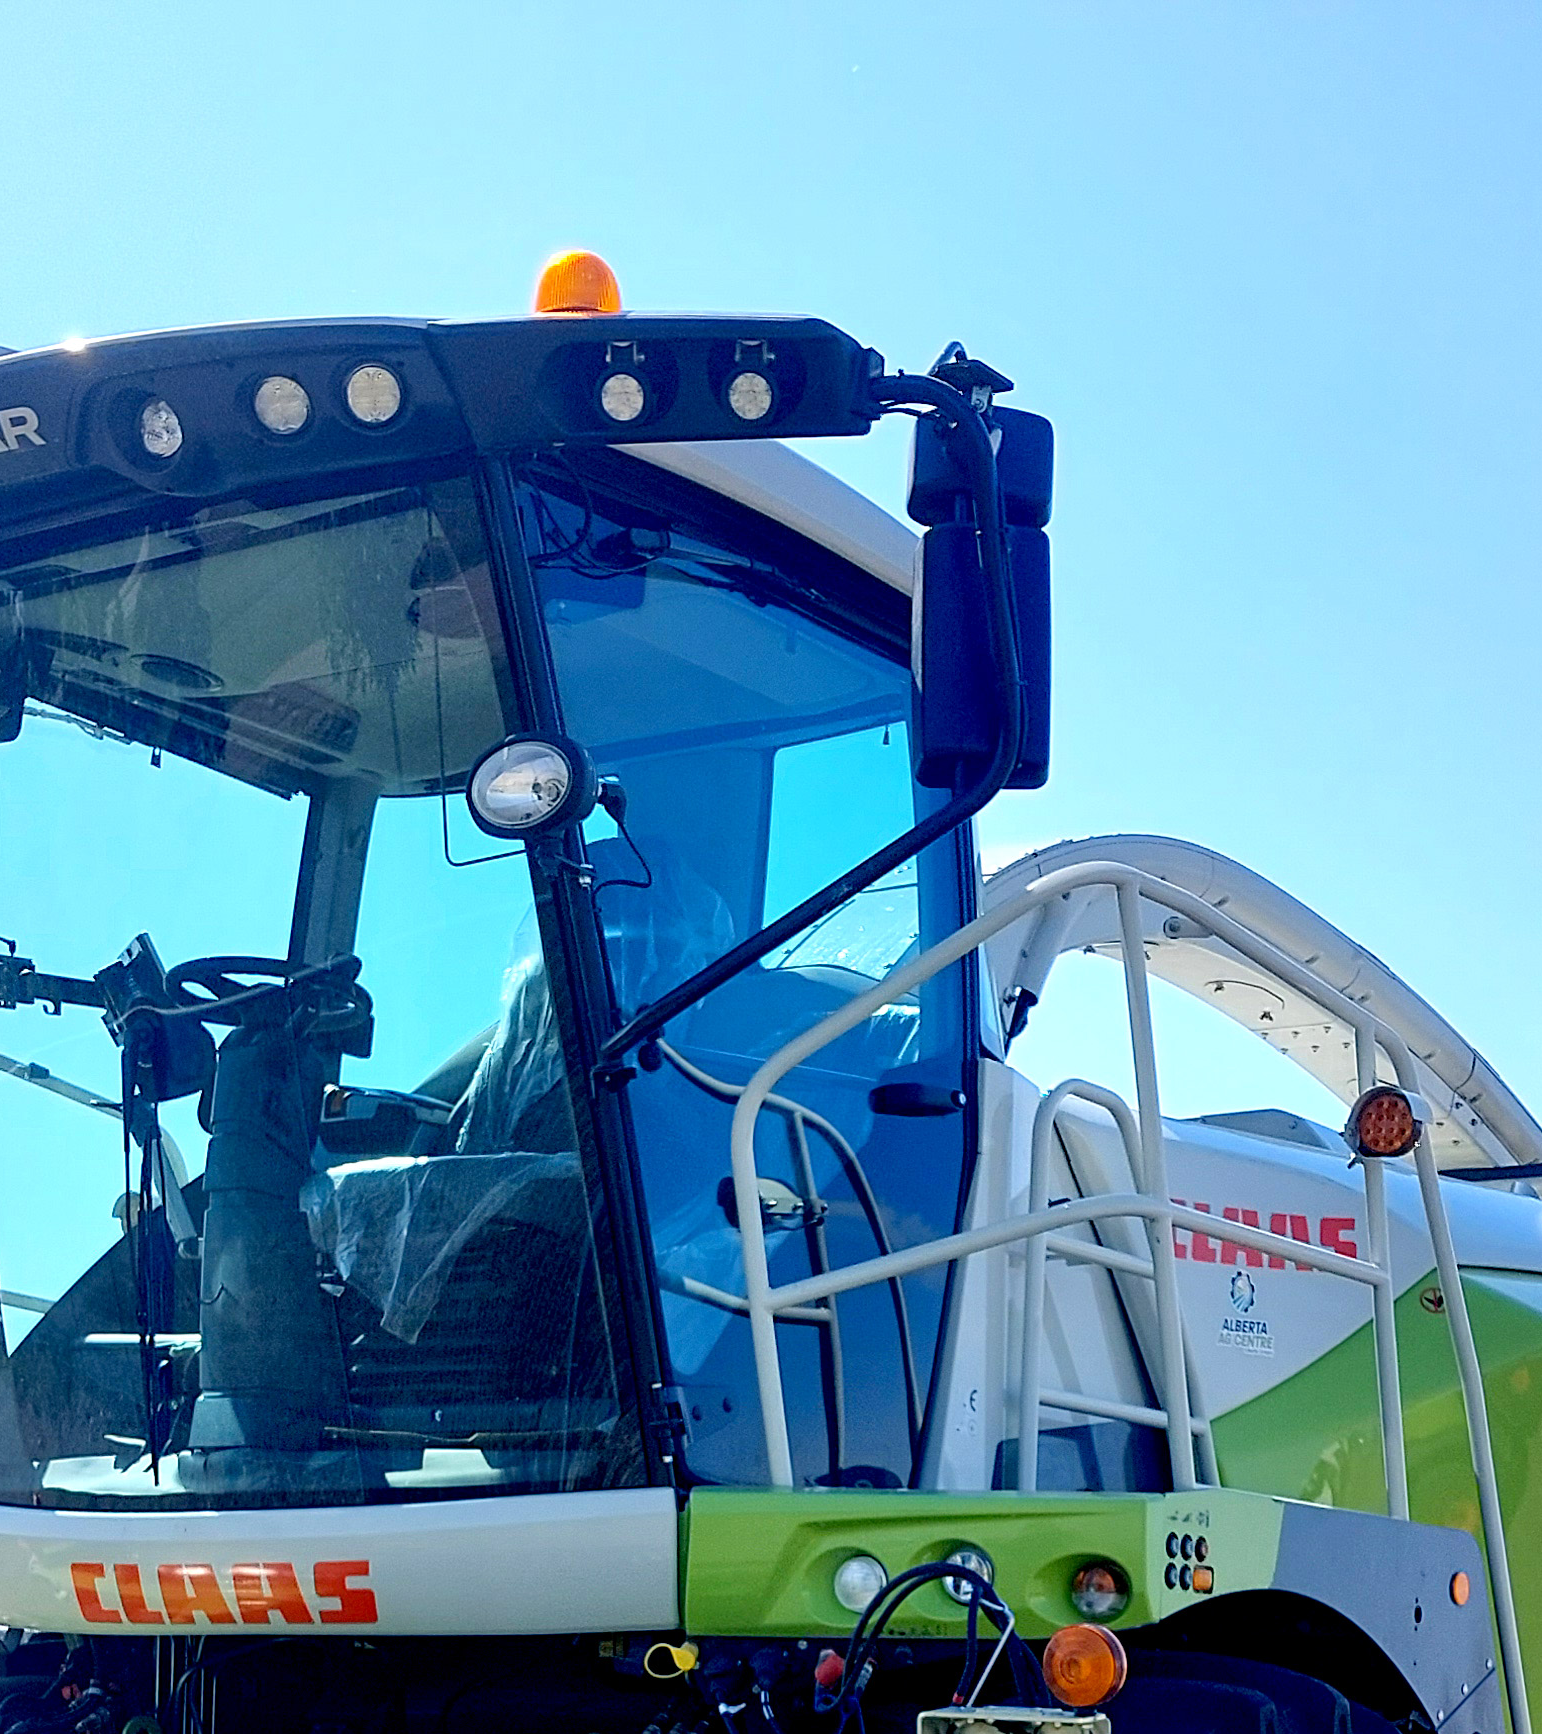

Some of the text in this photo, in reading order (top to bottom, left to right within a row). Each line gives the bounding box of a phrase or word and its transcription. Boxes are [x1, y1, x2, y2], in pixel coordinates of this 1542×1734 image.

[1222, 1318, 1268, 1335] ALBERTA
[1234, 1333, 1274, 1350] CENTRE
[70, 1560, 378, 1624] CLAAS
